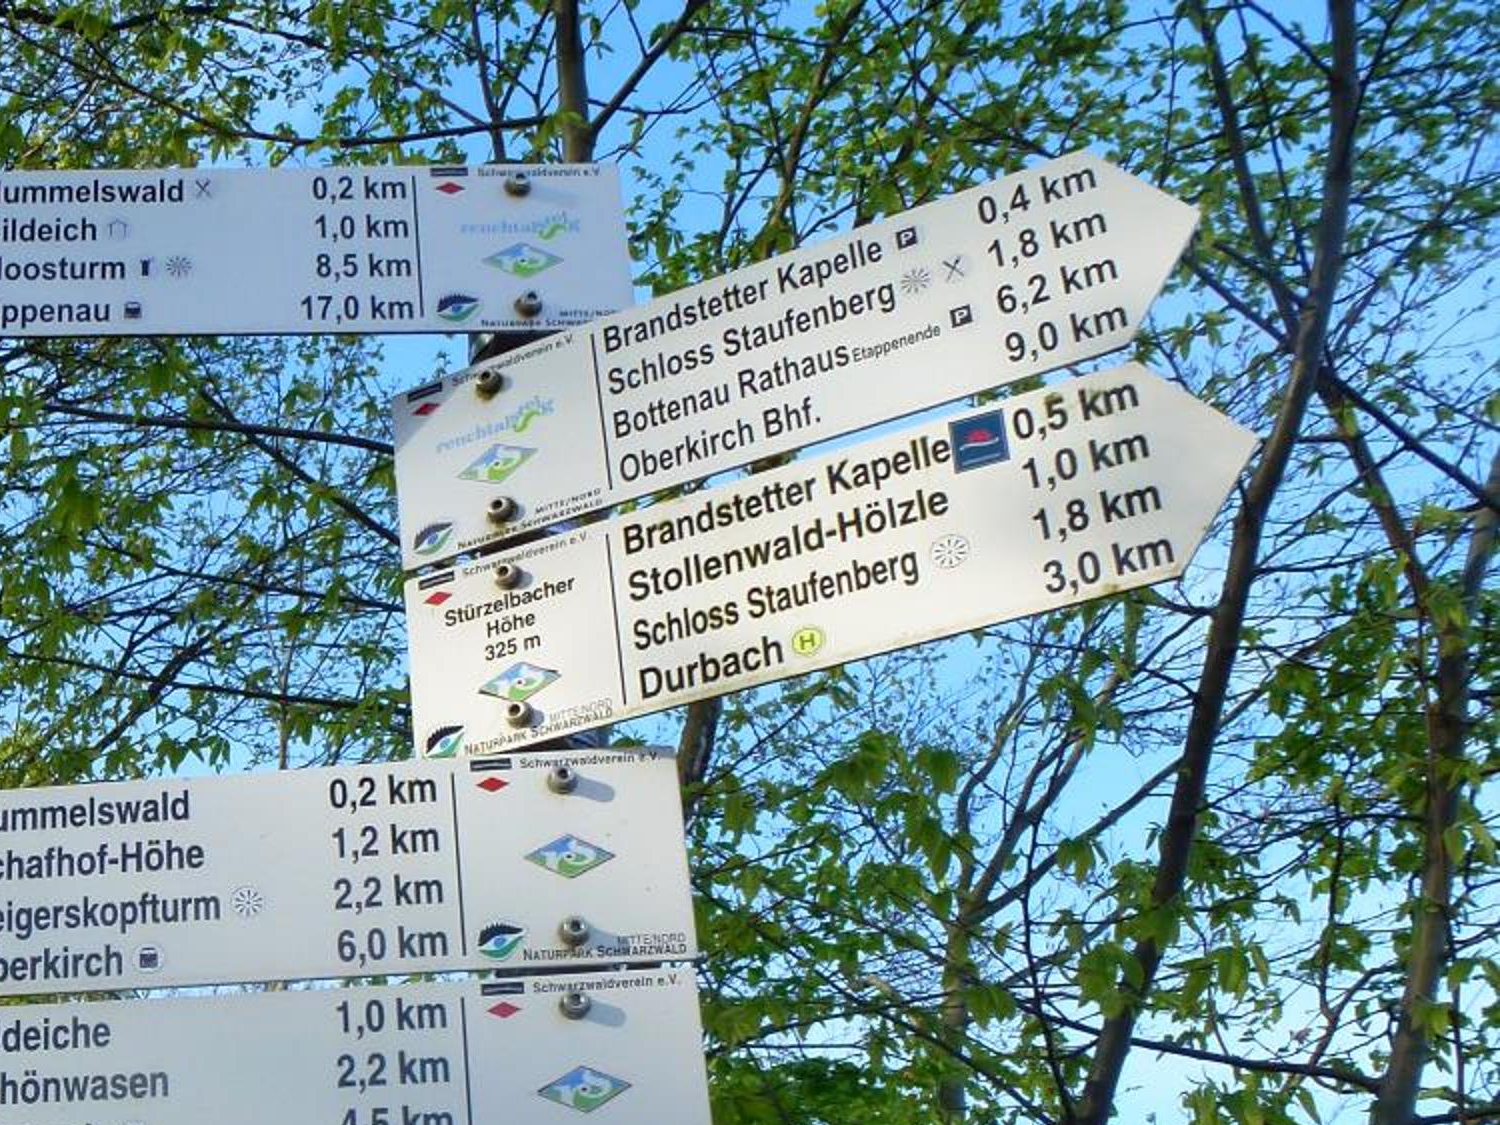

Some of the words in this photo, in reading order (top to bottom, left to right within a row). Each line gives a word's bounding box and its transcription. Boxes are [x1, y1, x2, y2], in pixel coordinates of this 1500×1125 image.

[312, 176, 353, 204] 0,2
[364, 176, 407, 199] km
[315, 215, 355, 243] 1,0
[366, 214, 409, 238] km
[316, 254, 358, 282] 8,5
[369, 254, 411, 277] km
[604, 279, 768, 352] Brandstetter
[778, 240, 883, 294] Kapelle
[977, 185, 1030, 225] 0,4
[1040, 167, 1096, 203] km
[300, 295, 359, 325] 17,0
[371, 295, 413, 320] km
[608, 344, 714, 395] Schloss
[723, 282, 895, 356] Staufenberg
[987, 229, 1039, 268] 1,8
[1049, 212, 1107, 249] km
[613, 383, 729, 438] Bottenau
[738, 344, 849, 398] Rathaus
[852, 325, 941, 363] Etappenende
[996, 273, 1050, 314] 6,2
[1060, 258, 1118, 295] km
[620, 419, 754, 482] Oberkirch
[763, 398, 822, 438] Bhf.
[1004, 321, 1058, 362] 9,0
[1070, 306, 1127, 343] km
[624, 476, 816, 554] Brandstetter
[826, 435, 951, 495] Kapelle
[1012, 397, 1068, 440] 0,5
[1078, 382, 1139, 421] km
[629, 488, 948, 601] Stollenwald-Hölzle
[1022, 447, 1078, 491] 1,0
[1089, 433, 1149, 472] km
[633, 601, 739, 650] Schloss
[747, 550, 920, 618] Staufenberg
[1032, 498, 1089, 542] 1,8
[1100, 484, 1162, 523] km
[444, 576, 576, 627] Stürzelbacher
[640, 635, 784, 699] Durbach
[1043, 550, 1100, 595] 3,0
[1112, 537, 1174, 576] km
[486, 611, 536, 638] Höhe
[485, 639, 517, 661] 325
[524, 635, 541, 650] m
[329, 777, 377, 814] 0,2
[389, 774, 436, 805] km
[332, 826, 379, 862] 1,2
[390, 823, 440, 854] km
[334, 877, 382, 914] 2,2
[394, 874, 444, 905] km
[337, 927, 386, 967] 6,0
[398, 926, 447, 958] km
[336, 1001, 384, 1039] 1,0
[397, 998, 447, 1030] km
[337, 1054, 387, 1092] 2,2
[398, 1051, 450, 1084] km
